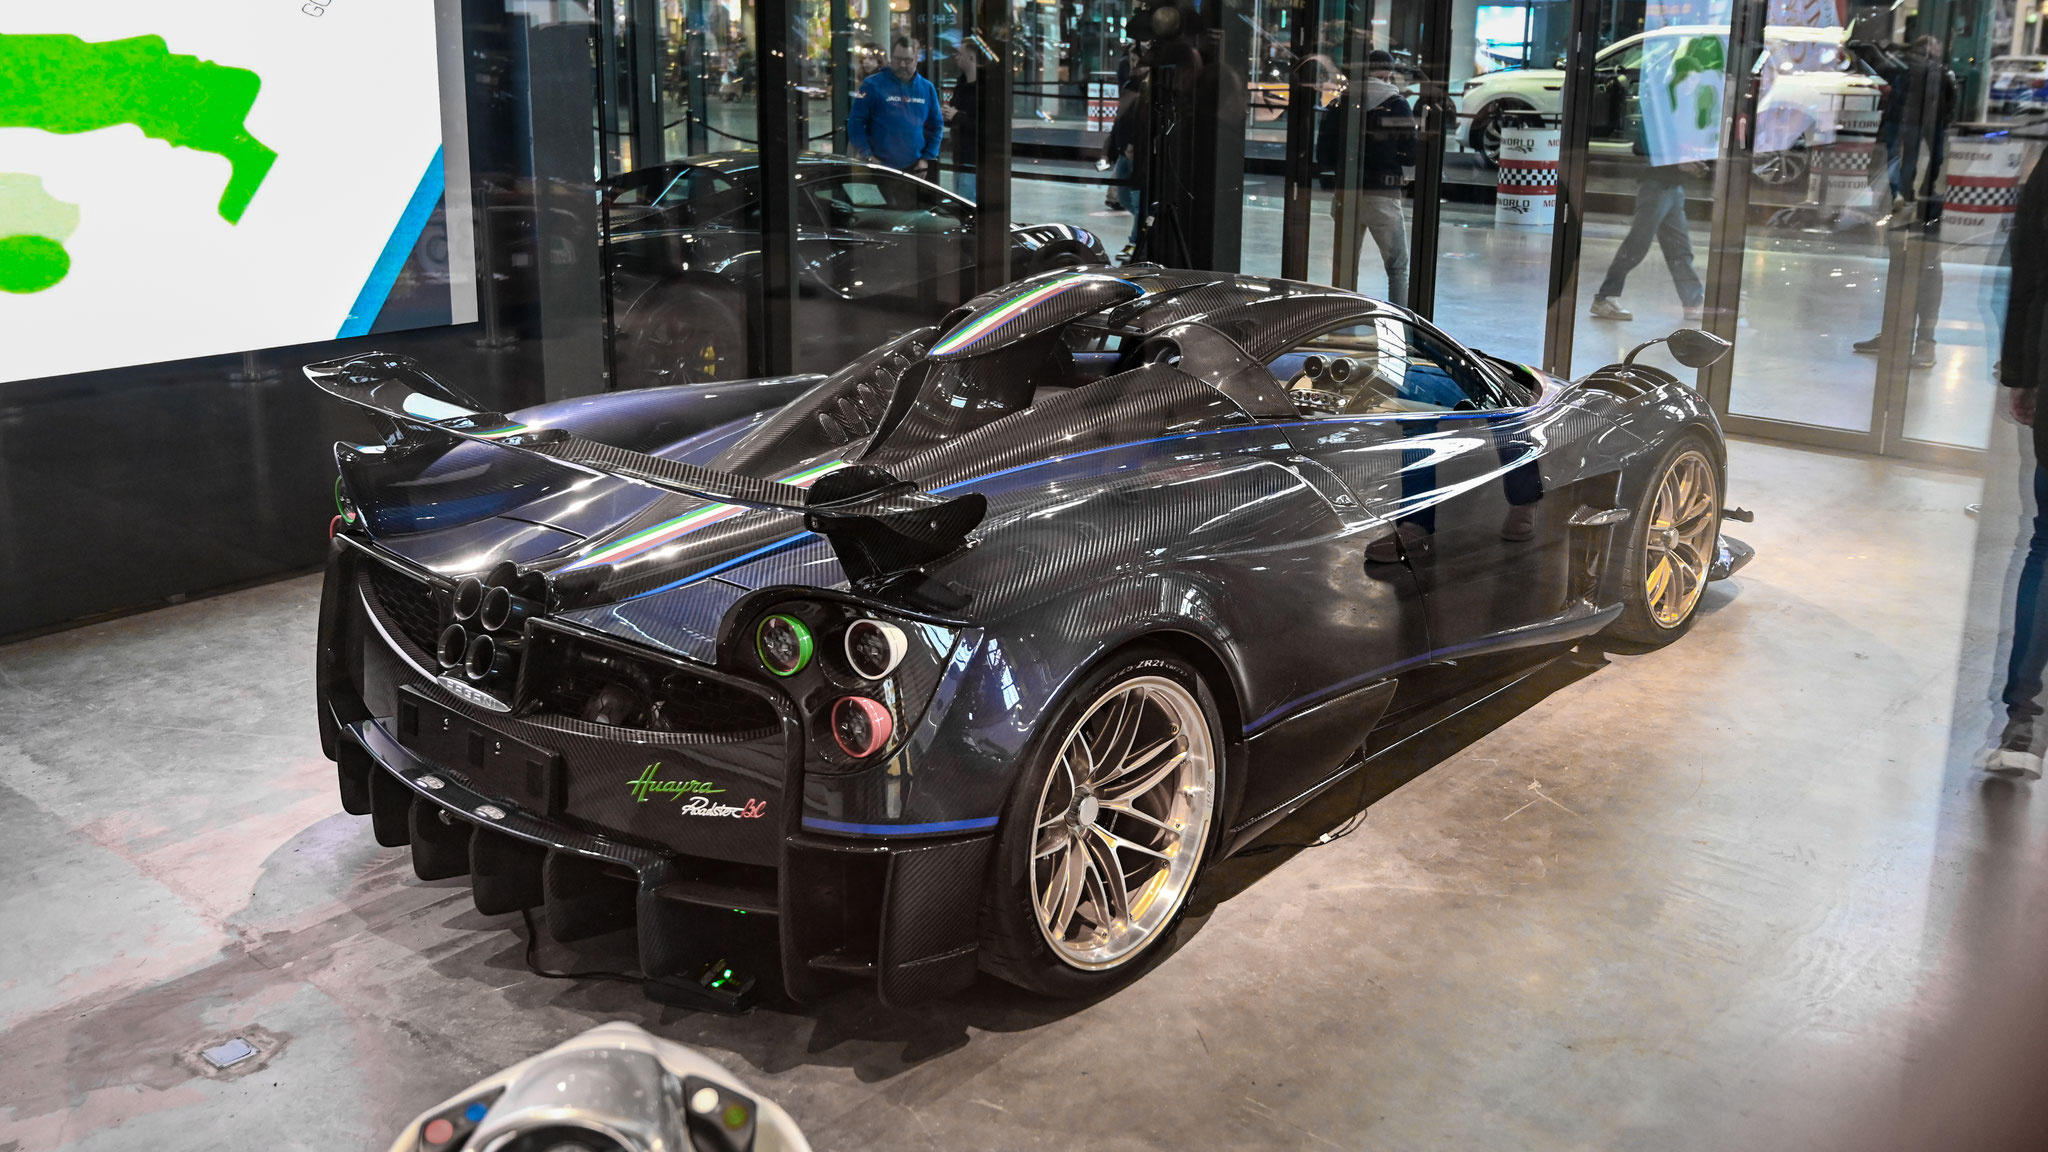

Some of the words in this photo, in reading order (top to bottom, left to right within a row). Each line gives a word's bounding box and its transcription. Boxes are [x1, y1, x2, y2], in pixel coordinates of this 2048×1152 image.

[1135, 659, 1165, 670] ZR21
[446, 680, 498, 710] PAGANI
[625, 761, 727, 802] Huayra
[681, 796, 746, 819] Roadster
